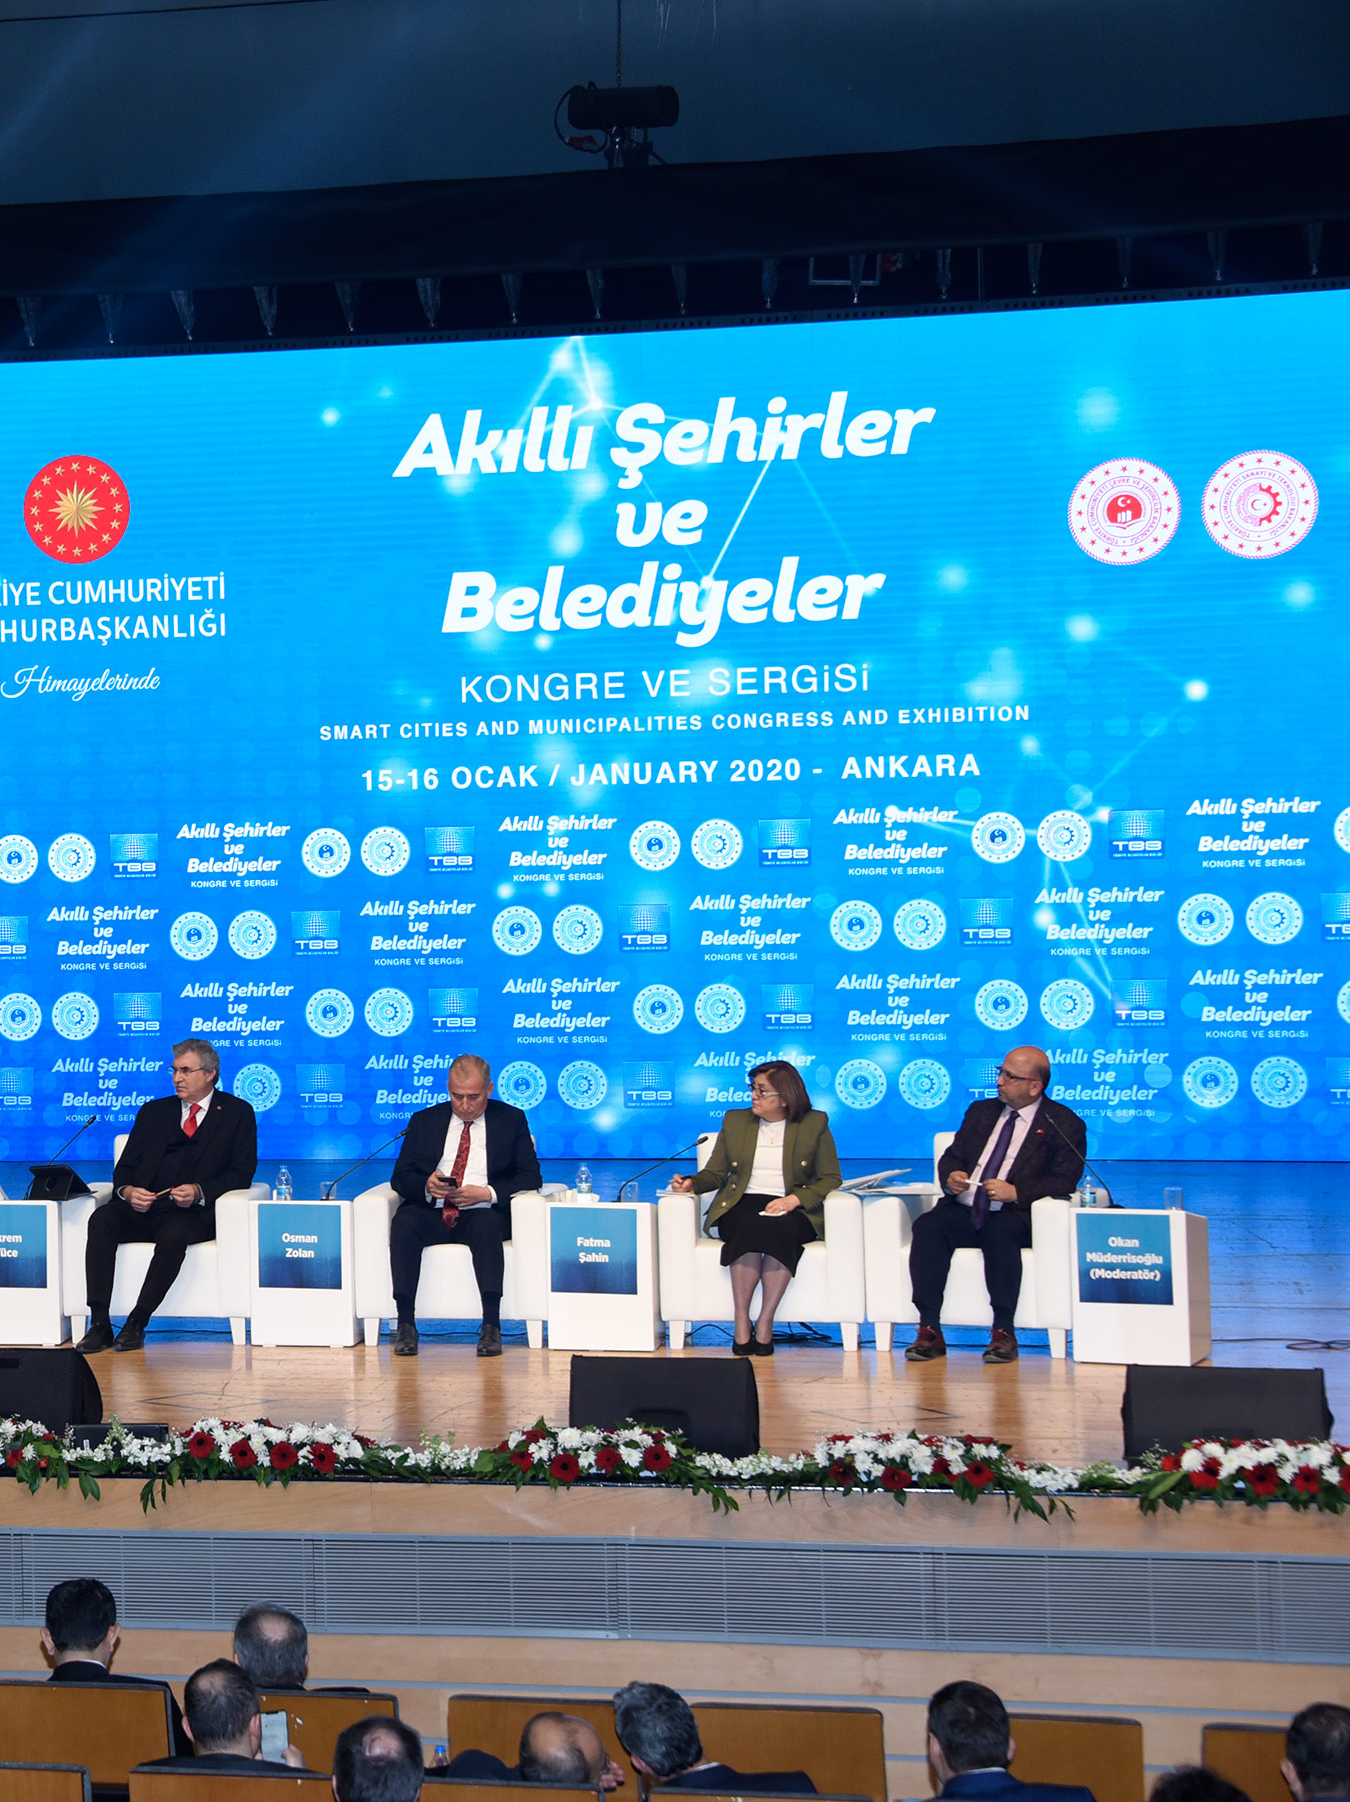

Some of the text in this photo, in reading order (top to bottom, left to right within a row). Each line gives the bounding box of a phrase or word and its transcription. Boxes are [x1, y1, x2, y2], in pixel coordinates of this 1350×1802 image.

[392, 390, 937, 489] Akıllı Şehirler
[615, 500, 708, 547] ve
[49, 572, 224, 604] CUMHURİYETİ
[441, 556, 886, 648] Belediyeler
[1, 665, 160, 701] Himayelerinde
[462, 672, 624, 702] KONGRE
[641, 670, 691, 699] VE
[320, 706, 1028, 740] SMART CITIES AND MUNICIPALITIES CONGRESS AND EXHIBITION
[362, 768, 438, 791] 15-16
[452, 765, 538, 788] OCAK
[570, 760, 719, 787] JANUARY
[730, 758, 800, 781] 2020
[842, 754, 980, 778] ANKARA
[833, 806, 958, 828] Akıllı Şehirler
[1186, 797, 1321, 819] Akıllı Şehirler
[176, 822, 290, 842] Akıllı Şehirler
[498, 814, 617, 835] Akıllı Şehirler
[1242, 821, 1266, 832] ve
[548, 837, 569, 848] ve
[885, 830, 907, 841] ve
[1198, 834, 1309, 855] Belediyeler
[224, 844, 244, 854] ve
[844, 843, 948, 863] Belediyeler
[187, 856, 281, 876] Belediyeler
[510, 850, 607, 870] Belediyeler
[1202, 860, 1244, 868] KONGRE
[1248, 859, 1261, 867] VE
[191, 880, 226, 888] KONGRE
[513, 874, 551, 882] KONGRE
[554, 873, 566, 881] VE
[690, 894, 811, 914] Akıllı Şehirler
[1035, 886, 1164, 908] Akıllı Şehirler
[47, 905, 158, 925] Akıllı Şehirler
[360, 900, 476, 920] Akıllı Şehirler
[1089, 910, 1111, 921] ve
[408, 922, 428, 932] ve
[740, 916, 761, 927] ve
[94, 928, 113, 937] ve
[700, 929, 800, 949] Belediyeler
[1046, 922, 1154, 943] Belediyeler
[57, 940, 149, 959] Belediyeler
[371, 934, 466, 954] Belediyeler
[502, 978, 620, 997] Akıllı Şehirler
[836, 974, 960, 994] Akıllı Şehirler
[1189, 969, 1323, 989] Akıllı Şehirler
[180, 982, 294, 1002] Akıllı Şehirler
[888, 996, 909, 1007] ve
[1245, 992, 1268, 1003] ve
[228, 1004, 248, 1014] ve
[552, 1000, 572, 1010] ve
[191, 1016, 284, 1036] Belediyeler
[514, 1012, 610, 1032] Belediyeler
[848, 1009, 950, 1029] Belediyeler
[1202, 1006, 1312, 1026] Belediyeler
[62, 1092, 154, 1110] Belediyeler
[1051, 1085, 1158, 1105] Belediyeler
[281, 1232, 319, 1244] Osman
[576, 1236, 611, 1248] Fatma
[1107, 1236, 1140, 1248] Okan
[285, 1247, 315, 1259] Zolan
[578, 1251, 609, 1264] Şahin
[1085, 1251, 1164, 1266] Müderrisoğlu
[1089, 1267, 1161, 1282] (Moderatör)
